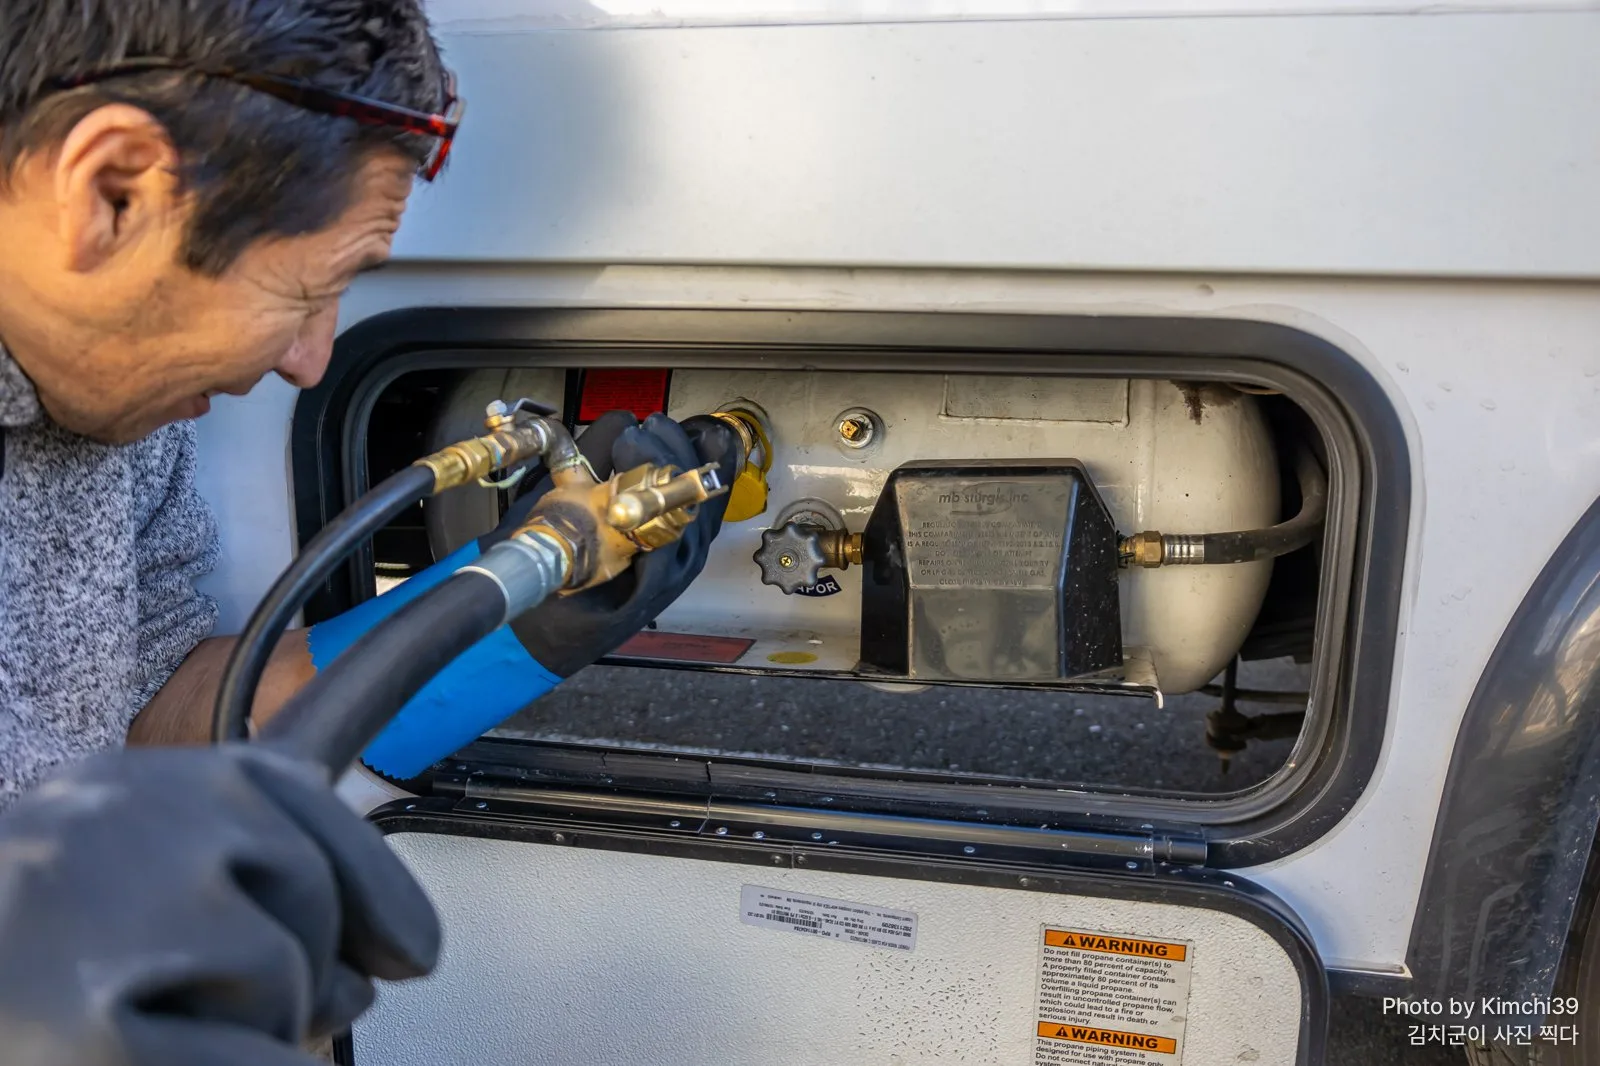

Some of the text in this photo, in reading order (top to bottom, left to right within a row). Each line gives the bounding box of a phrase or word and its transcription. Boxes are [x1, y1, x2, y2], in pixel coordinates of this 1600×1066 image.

[939, 493, 959, 503] mb
[1079, 935, 1168, 956] WARNING
[1082, 953, 1113, 962] propane
[1115, 956, 1162, 967] container(s)
[1094, 961, 1123, 970] percent
[1135, 966, 1168, 976] capacity.
[1042, 969, 1095, 981] approximately
[1108, 978, 1137, 987] percent
[1050, 963, 1081, 973] properly
[1104, 970, 1140, 979] container
[1142, 974, 1175, 983] contains
[1042, 976, 1069, 984] volume
[1078, 980, 1098, 989] liquid
[1040, 998, 1062, 1006] which
[1041, 983, 1079, 994] Overfilling
[1082, 989, 1113, 999] propane
[1114, 993, 1160, 1004] container(s)
[1040, 1005, 1075, 1015] explosion
[1073, 995, 1120, 1006] uncontrolled
[1122, 1001, 1154, 1011] propane
[1156, 1005, 1174, 1013] flow,
[1039, 1012, 1066, 1021] serious
[1071, 1027, 1158, 1048] WARNING
[1036, 1046, 1068, 1055] designed
[1115, 1057, 1145, 1066] propane
[1054, 1041, 1083, 1051] propane
[1086, 1045, 1108, 1054] piping
[1110, 1049, 1137, 1058] system
